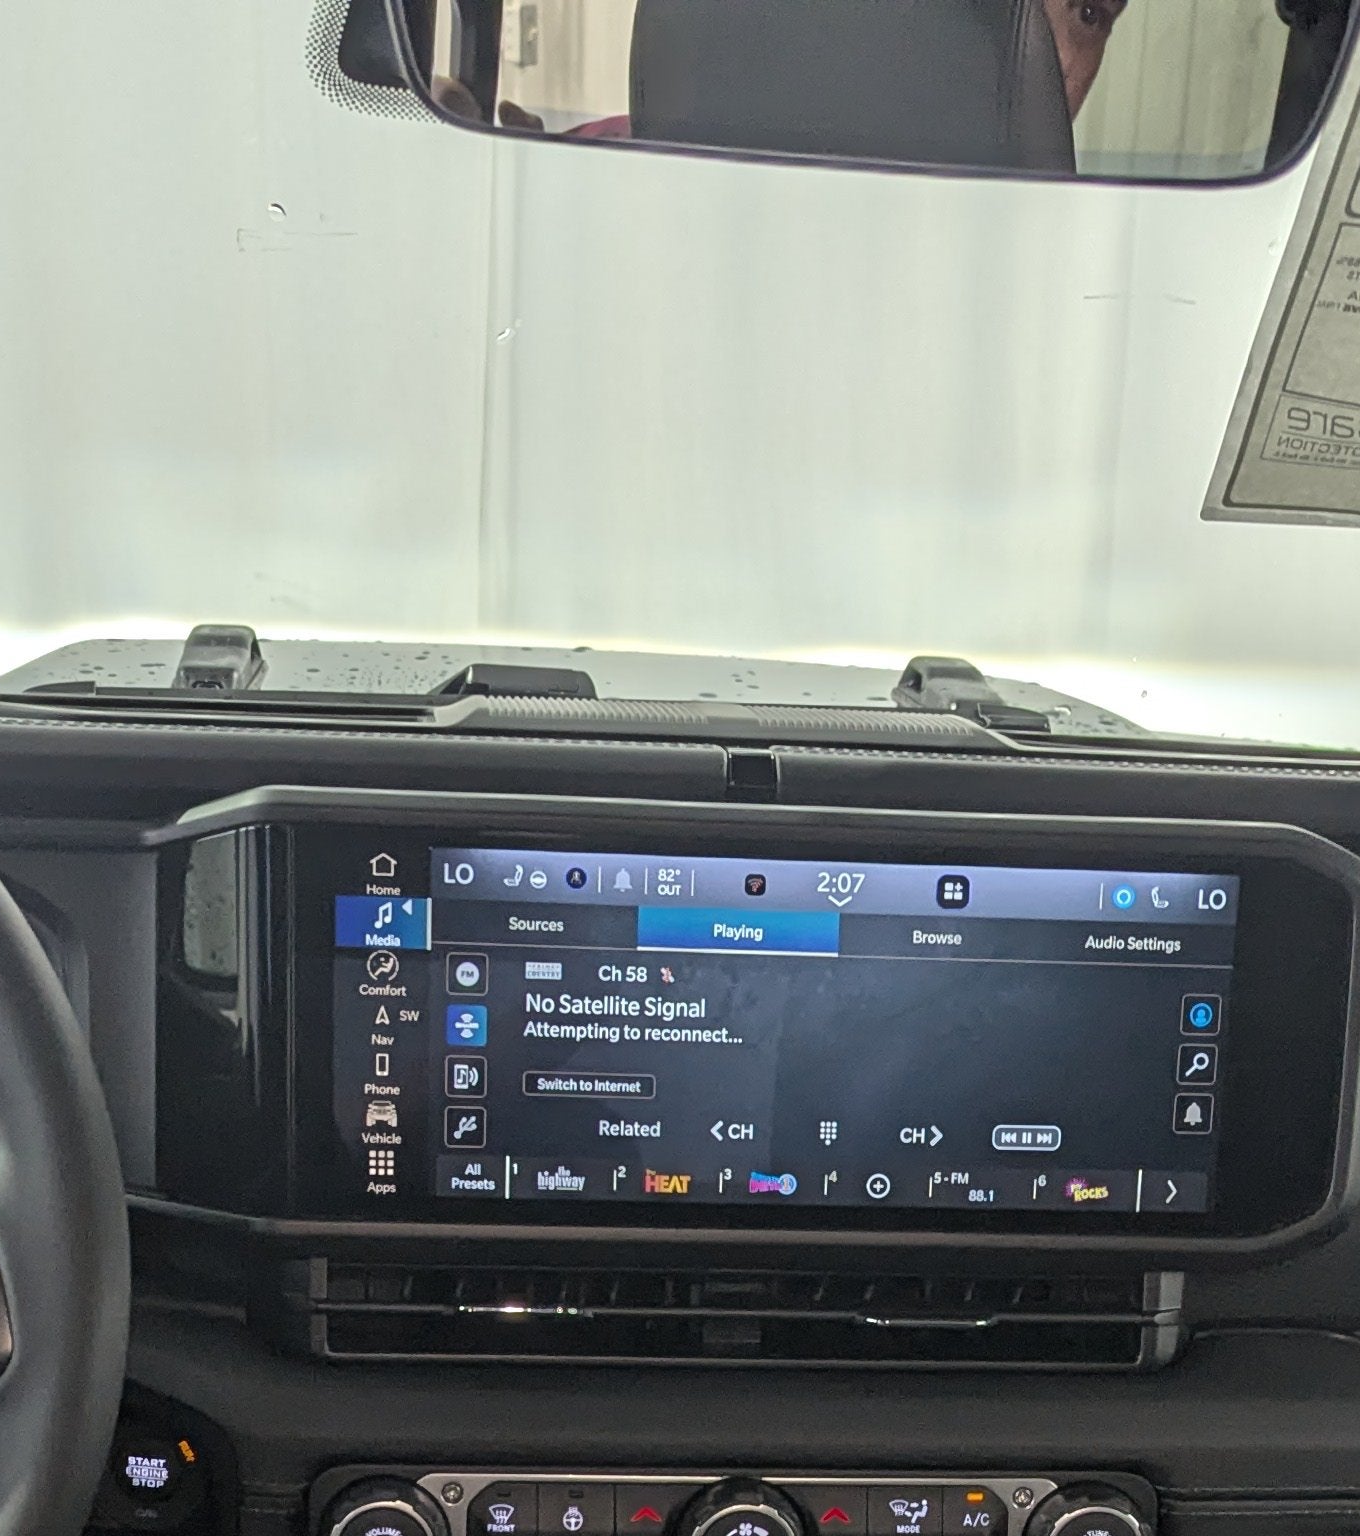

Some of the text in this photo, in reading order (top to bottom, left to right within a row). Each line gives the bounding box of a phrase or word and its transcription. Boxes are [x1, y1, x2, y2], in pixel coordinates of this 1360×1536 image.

[443, 863, 474, 884] LO
[658, 869, 681, 882] 82°
[366, 883, 401, 897] Home
[657, 884, 681, 896] OUT
[817, 873, 865, 893] 2:07
[1198, 889, 1227, 909] LO
[508, 916, 564, 932] Sources
[713, 924, 763, 941] Playing
[912, 930, 962, 945] Browse
[365, 933, 401, 947] Media
[1085, 936, 1181, 953] Audio Settings
[598, 966, 648, 982] Ch 58
[359, 983, 407, 997] Comfort
[525, 993, 706, 1020] No Satellite Signal
[399, 1010, 420, 1022] SW
[523, 1021, 742, 1043] Attempting to reconnect...
[371, 1034, 394, 1046] Nav
[364, 1083, 400, 1096] Phone
[537, 1077, 641, 1093] Switch to Internet
[599, 1121, 661, 1138] Related
[728, 1124, 754, 1140] CH
[900, 1128, 925, 1144] CH
[361, 1133, 402, 1145] Vehicle
[465, 1164, 481, 1175] All
[451, 1177, 495, 1191] Presets
[537, 1171, 585, 1191] highway
[645, 1174, 691, 1194] HEAT
[367, 1182, 396, 1195] Apps
[1073, 1186, 1109, 1201] ROCKS
[969, 1190, 995, 1202] 88.1
[128, 1456, 166, 1467] START
[126, 1468, 168, 1478] ENGINE
[132, 1478, 164, 1488] STOP
[963, 1514, 990, 1528] A/C
[487, 1524, 516, 1533] FRONT
[896, 1525, 920, 1534] MODE
